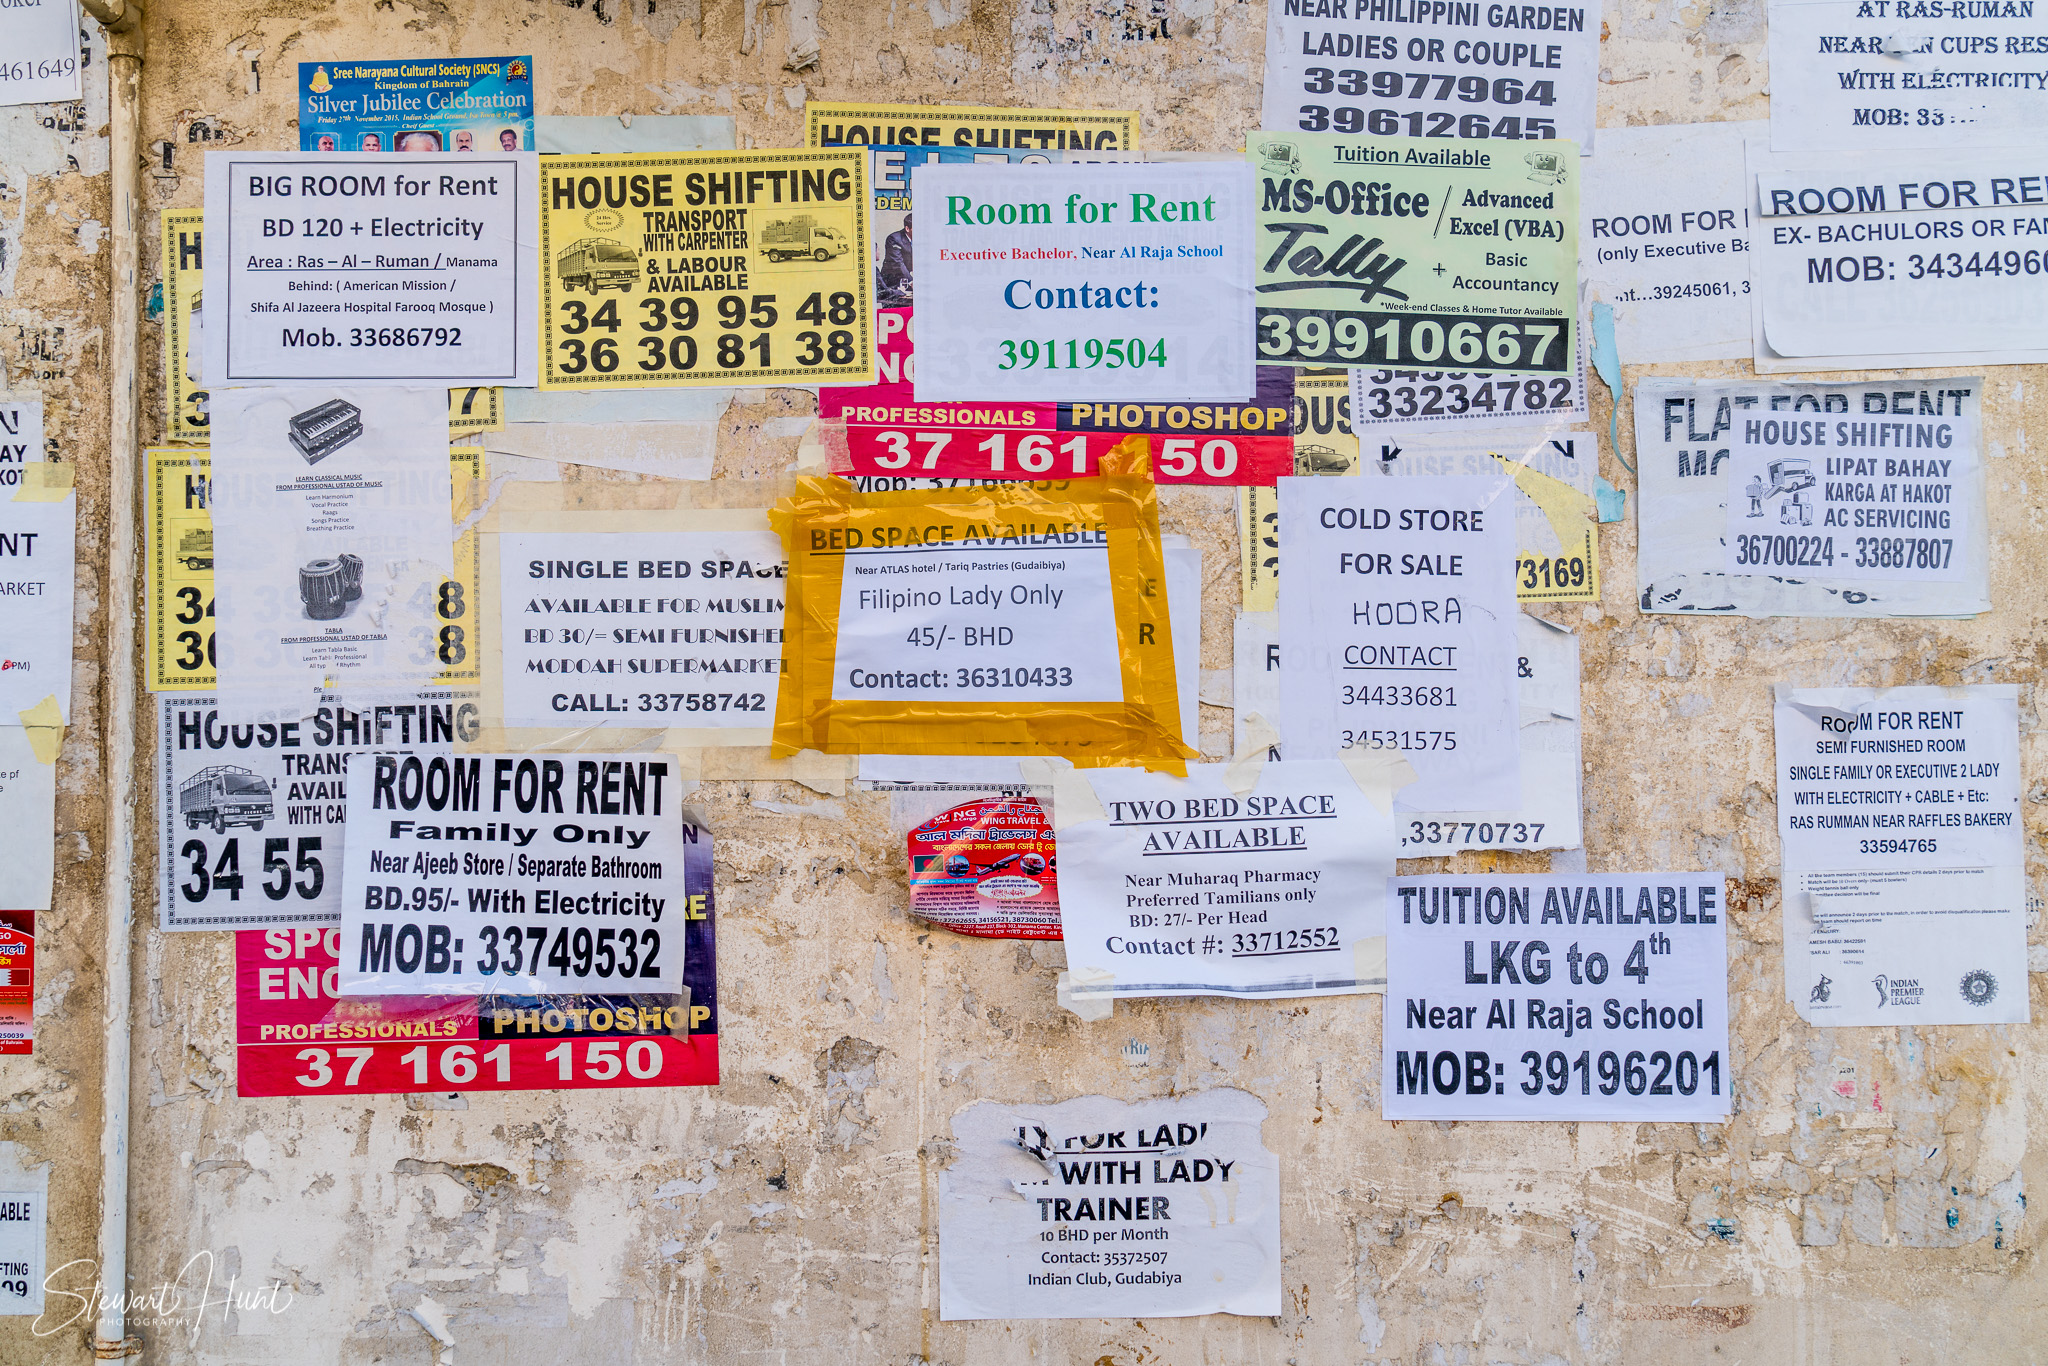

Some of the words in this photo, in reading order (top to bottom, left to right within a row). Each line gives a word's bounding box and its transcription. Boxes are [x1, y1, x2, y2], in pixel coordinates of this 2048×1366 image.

[1303, 32, 1398, 60] LADIES
[1407, 38, 1444, 63] OR
[1453, 41, 1562, 68] COUPLE
[333, 66, 353, 79] Sree
[354, 65, 399, 81] Narayana
[401, 64, 437, 78] Cultural
[439, 64, 471, 78] Society
[472, 62, 500, 77] (SNCS)
[374, 81, 417, 91] Kingdom
[420, 80, 430, 89] of
[432, 79, 469, 88] Bahrain
[1304, 67, 1557, 106] 33977964
[308, 94, 357, 115] Silver
[362, 92, 421, 114] Jubilee
[426, 90, 527, 109] Celebration
[1334, 145, 1399, 163] Tuition
[1405, 148, 1491, 166] Available
[552, 174, 672, 209] HOUSE
[685, 168, 851, 206] SHIFTING
[1262, 178, 1429, 217] MS-Office
[1462, 188, 1554, 209] Advanced
[946, 196, 1052, 225] Room
[1065, 193, 1117, 224] for
[1129, 193, 1216, 223] Rent
[263, 219, 294, 236] BD
[302, 219, 343, 236] 120
[371, 218, 484, 240] Electricity
[1450, 218, 1499, 237] Excel
[1504, 221, 1564, 242] (VBA)
[1592, 214, 1672, 238] ROOM
[1681, 210, 1735, 232] FOR
[1774, 227, 1811, 245] EX-
[1818, 222, 1963, 243] BACHULORS
[1971, 220, 2005, 237] OR
[643, 233, 674, 251] WITH
[678, 231, 748, 250] CARPENTER
[940, 248, 1007, 261] Executive
[1012, 248, 1077, 261] Bachelor,
[1081, 247, 1115, 259] Near
[1121, 246, 1136, 258] Al
[1140, 245, 1173, 261] Raja
[1178, 244, 1223, 258] School
[1485, 253, 1528, 267] Basic
[1597, 246, 1638, 264] (only
[1645, 240, 1726, 258] Executive
[288, 281, 333, 291] Behind:
[343, 281, 399, 291] American
[402, 280, 447, 291] Mission
[648, 274, 749, 292] AVAILABLE
[1453, 274, 1559, 295] Accountancy
[1004, 279, 1159, 309] Contact:
[251, 302, 279, 312] Shifa
[282, 302, 295, 312] Al
[297, 302, 341, 313] Jazeera
[344, 302, 392, 315] Hospital
[395, 301, 435, 315] Farooq
[439, 301, 486, 314] Mosque
[1430, 303, 1460, 313] Classes
[1463, 304, 1470, 313] &
[1472, 305, 1497, 315] Home
[1500, 306, 1522, 315] Tutor
[1525, 306, 1563, 316] Available
[1258, 315, 1559, 366] 39910667
[999, 338, 1167, 370] 39119504
[1827, 458, 1877, 477] LIPAT
[1885, 459, 1951, 478] BAHAY
[1825, 483, 1874, 502] KARGA
[1881, 484, 1898, 502] AT
[1903, 484, 1951, 503] HAKOT
[1320, 508, 1390, 530] COLD
[1399, 509, 1483, 531] STORE
[1737, 535, 1833, 566] 36700224
[1856, 537, 1953, 569] 33887807
[529, 560, 628, 579] SINGLE
[639, 560, 691, 578] BED
[855, 565, 878, 575] Near
[880, 564, 909, 574] ATLAS
[911, 563, 936, 573] hotel
[945, 562, 969, 574] Tariq
[971, 561, 1009, 572] Pastries
[1011, 560, 1066, 572] (Gudaibiya)
[859, 587, 942, 612] Filipino
[950, 586, 1001, 609] Lady
[1010, 584, 1063, 608] Only
[525, 659, 622, 673] MODOAH
[627, 659, 788, 673] SUPERMARKET
[1344, 646, 1457, 665] CONTACT
[552, 693, 628, 711] CALL:
[638, 693, 765, 711] 33758742
[1342, 686, 1457, 706] 34433681
[1816, 741, 1847, 754] SEMI
[1851, 741, 1923, 753] FURNISHED
[1927, 739, 1965, 752] ROOM
[1790, 766, 1830, 780] SINGLE
[1834, 765, 1873, 779] FAMILY
[1876, 765, 1892, 779] OR
[1896, 764, 1958, 779] EXECUTIVE
[1961, 764, 1967, 778] 2
[1970, 763, 2000, 778] LADY
[982, 817, 1006, 825] WING
[1790, 816, 1813, 829] RAS
[1817, 815, 1869, 828] RUMMAN
[1873, 815, 1904, 828] NEAR
[1909, 814, 1961, 828] RAFFLES
[1965, 813, 2012, 826] BAKERY
[391, 821, 538, 846] Family
[553, 825, 650, 849] Only
[1860, 840, 1937, 853] 33594765
[370, 850, 409, 873] Near
[413, 851, 458, 875] Ajeeb
[463, 853, 505, 875] Store
[517, 854, 587, 878] Separate
[591, 855, 661, 879] Bathroom
[1126, 873, 1163, 887] Near
[1167, 870, 1238, 890] Muharaq
[1243, 868, 1321, 888] Pharmacy
[1126, 892, 1200, 907] Preferred
[1205, 889, 1280, 905] Tamilians
[1285, 888, 1316, 903] only
[1232, 927, 1339, 953] 33712552
[359, 924, 463, 974] MOB:
[478, 926, 661, 978] 33749532
[1465, 941, 1551, 984] LKG
[1567, 942, 1608, 984] to
[1891, 979, 1919, 987] INDIAN
[1891, 988, 1924, 996] PREMIER
[1891, 997, 1921, 1005] LEAGUE
[494, 1007, 711, 1034] PHOTOSHOP
[1406, 999, 1477, 1029] Near
[1486, 999, 1515, 1029] Al
[1528, 999, 1592, 1037] Raja
[1603, 998, 1703, 1029] School
[1520, 1051, 1720, 1096] 39196201
[1037, 1197, 1171, 1221] TRAINER
[1040, 1231, 1054, 1241] 10
[1058, 1230, 1089, 1241] BHD
[1093, 1231, 1117, 1244] per
[1121, 1228, 1169, 1240] Month
[1041, 1251, 1099, 1264] Contact:
[1103, 1251, 1168, 1266] 35372507
[1028, 1273, 1071, 1285] Indian
[1076, 1272, 1111, 1287] Club,
[1115, 1272, 1182, 1285] Gudabiya
